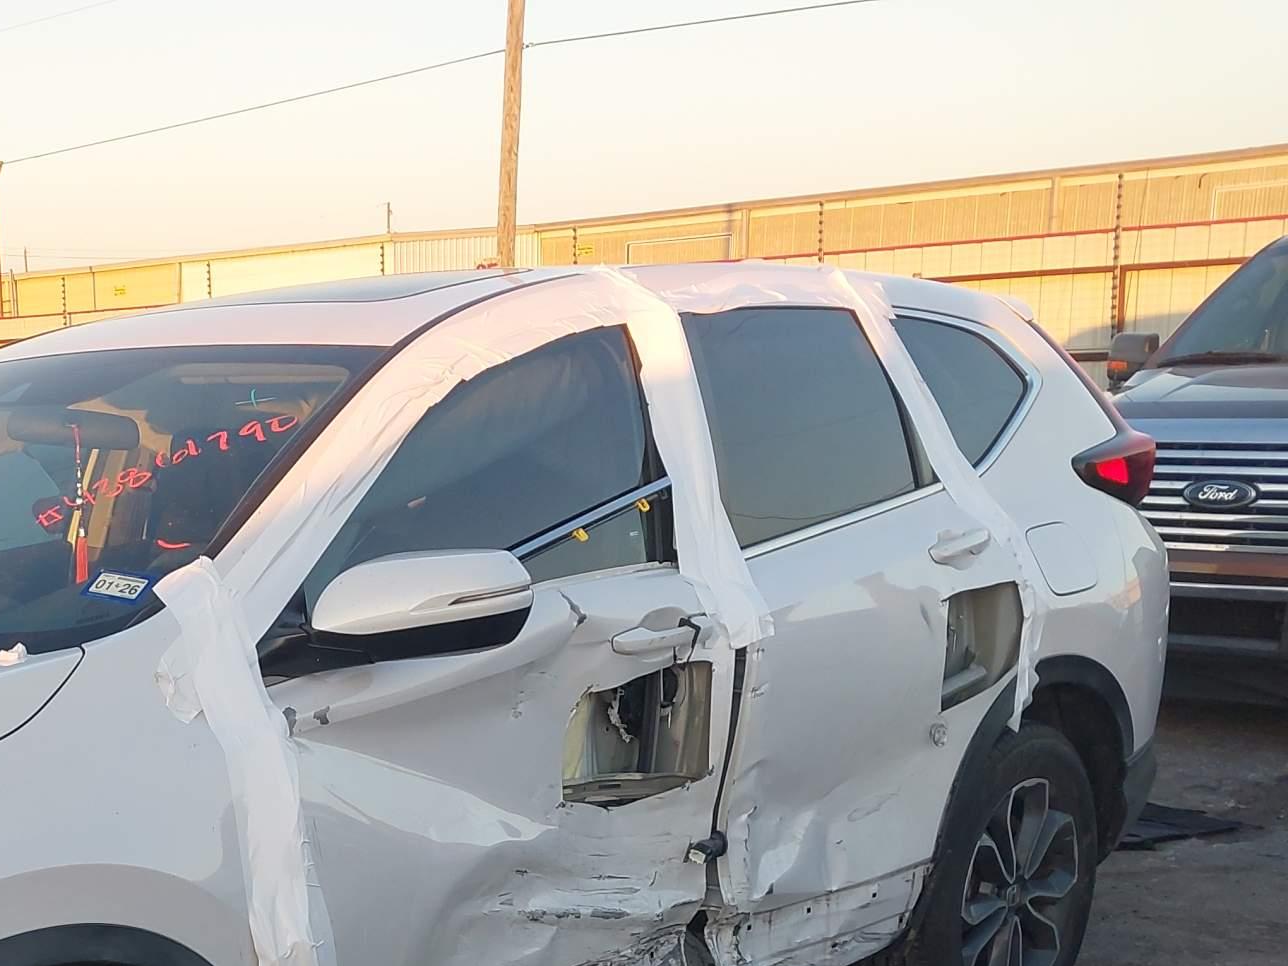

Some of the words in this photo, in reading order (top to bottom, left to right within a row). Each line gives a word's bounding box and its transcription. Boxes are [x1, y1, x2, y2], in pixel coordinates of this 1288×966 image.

[1198, 484, 1238, 501] Ford
[95, 579, 114, 592] 01
[118, 583, 141, 596] 26
